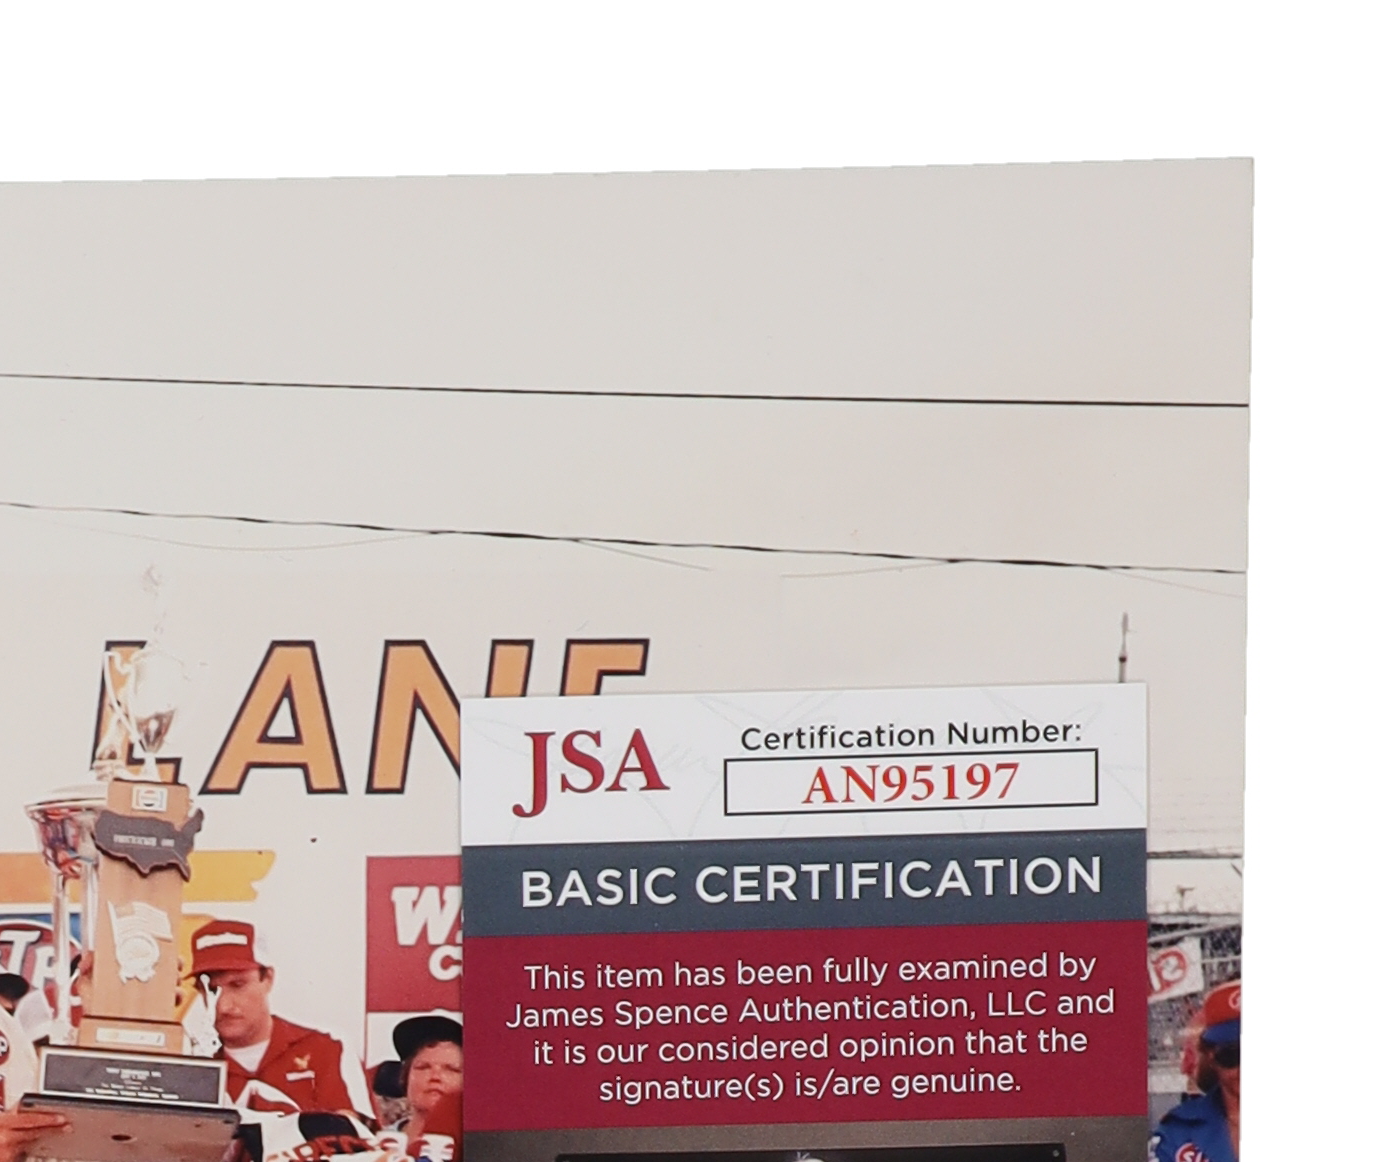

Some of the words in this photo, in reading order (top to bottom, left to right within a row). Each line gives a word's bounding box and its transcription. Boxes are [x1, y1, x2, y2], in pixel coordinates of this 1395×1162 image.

[741, 723, 935, 752] Certification
[947, 719, 1083, 747] Number:
[512, 729, 670, 818] JSA
[802, 762, 1020, 805] AN95197
[522, 866, 678, 908] BASIC
[696, 857, 1102, 904] CERTIFICATION
[524, 964, 586, 991] This
[595, 963, 663, 989] item
[673, 962, 726, 987] has
[736, 960, 812, 986] been
[822, 956, 889, 988] fully
[899, 953, 1047, 983] examined
[1058, 951, 1097, 982] by
[506, 1003, 604, 1030] James
[614, 1000, 728, 1031] Spence
[738, 993, 976, 1023] Authentication,
[987, 991, 1046, 1018] LLC
[1057, 988, 1114, 1016] and
[533, 1038, 553, 1065] it
[563, 1038, 586, 1065] is
[596, 1042, 649, 1064] our
[658, 1033, 828, 1062] considered
[839, 1031, 954, 1063] opinion
[965, 1029, 1026, 1057] that
[1036, 1027, 1088, 1055] the
[599, 1072, 784, 1105] signature(s)
[794, 1069, 881, 1100] is/are
[891, 1068, 1022, 1099] genuine.
